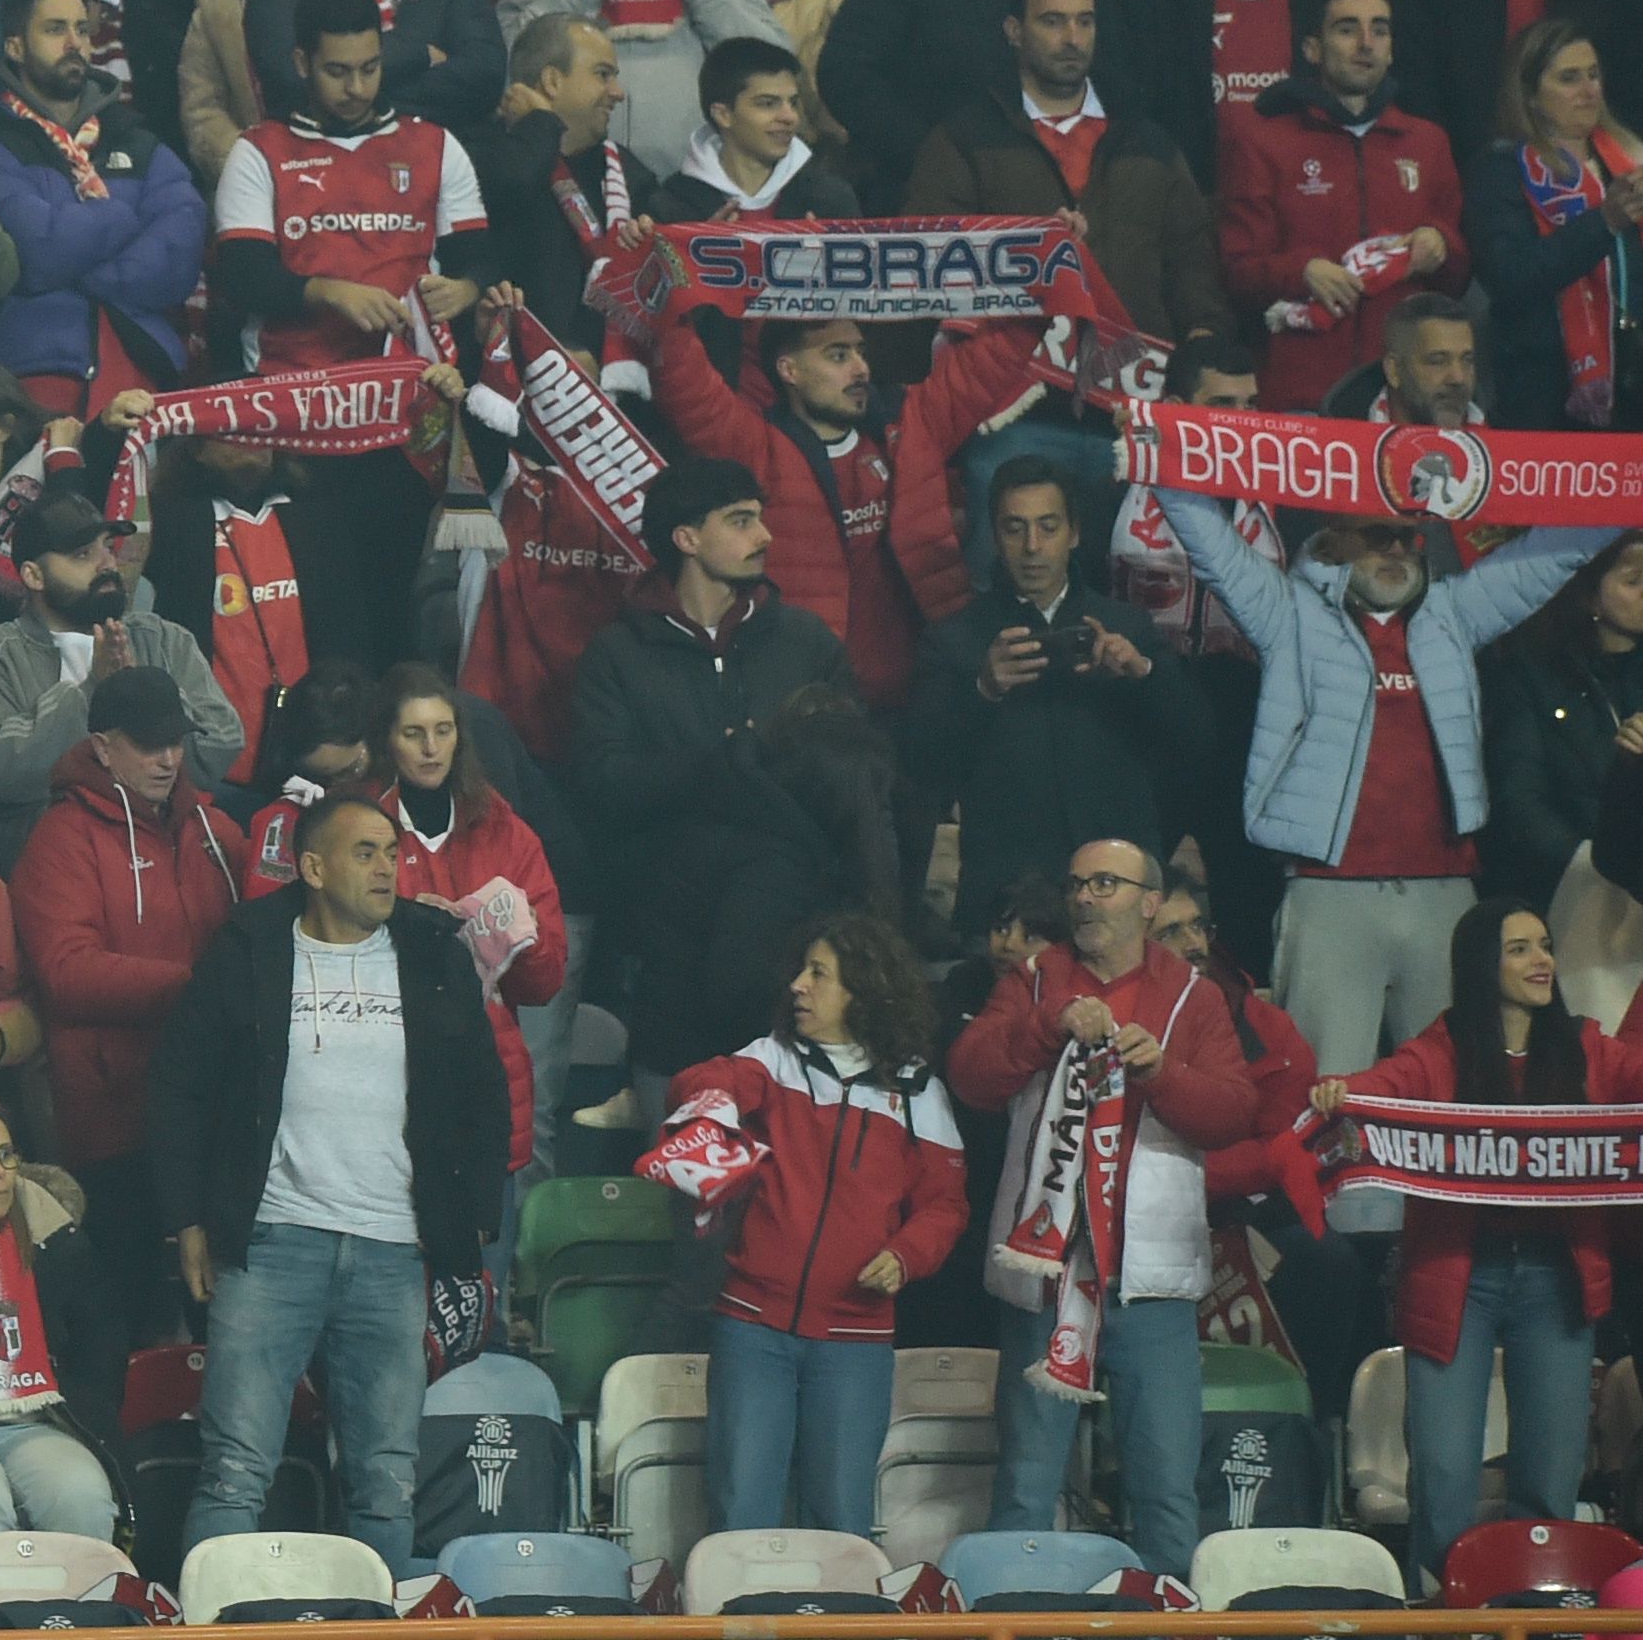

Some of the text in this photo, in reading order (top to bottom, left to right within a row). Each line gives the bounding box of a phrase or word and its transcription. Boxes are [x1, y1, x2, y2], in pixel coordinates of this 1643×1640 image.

[310, 213, 427, 234] SOLVERDE.PT
[744, 295, 836, 315] ESTADIO
[849, 295, 959, 315] MUNICIPAL
[296, 375, 404, 432] FORÇA
[1177, 420, 1361, 503] BRAGA
[1366, 1123, 1632, 1183] QUEM NÃO SENTE,
[465, 1445, 519, 1459] Allianz
[481, 1460, 503, 1470] CUP
[1220, 1459, 1273, 1475] Allianz
[1233, 1475, 1255, 1486] CUP
